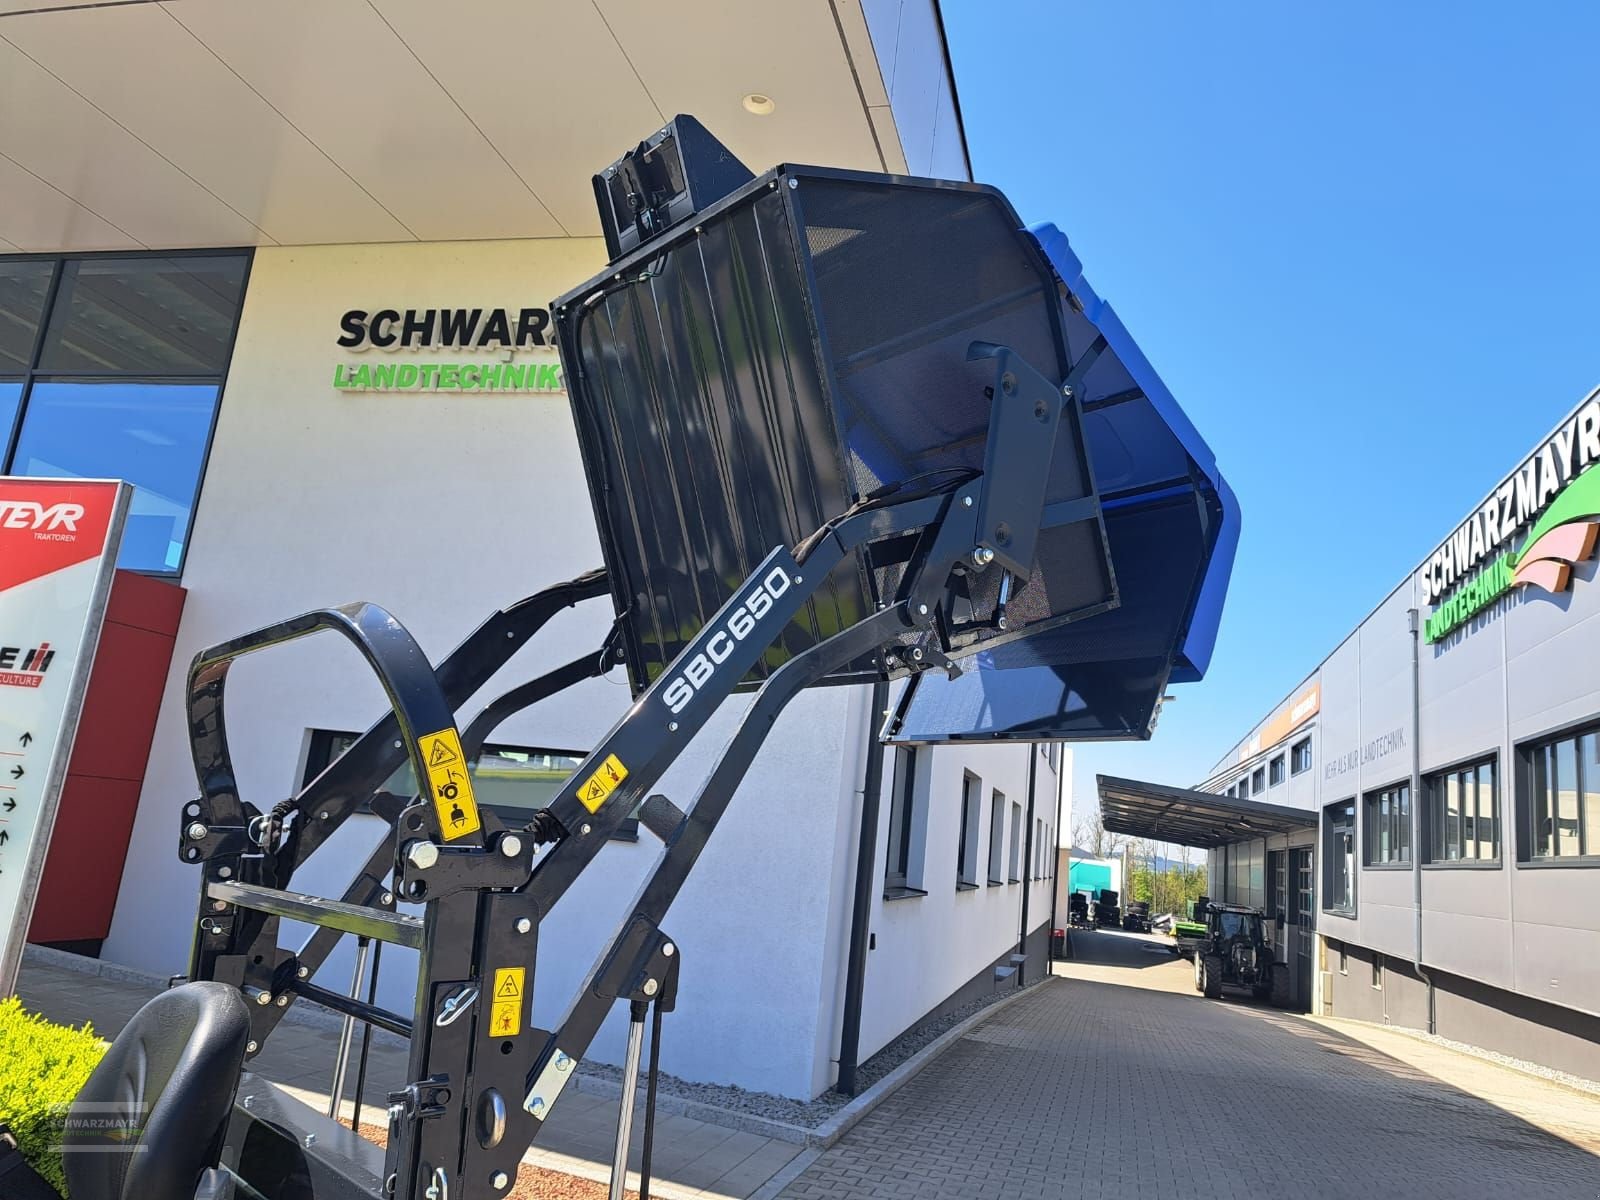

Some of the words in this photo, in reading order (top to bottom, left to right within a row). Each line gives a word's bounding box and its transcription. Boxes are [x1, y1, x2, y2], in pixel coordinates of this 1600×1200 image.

[337, 308, 558, 347] SCHWAR
[333, 364, 561, 389] LANDTECHNIK
[1421, 402, 1600, 606] SCHWARZMAYR
[34, 532, 76, 542] TRAKTOREN
[1424, 553, 1514, 645] LANDTECHNIK
